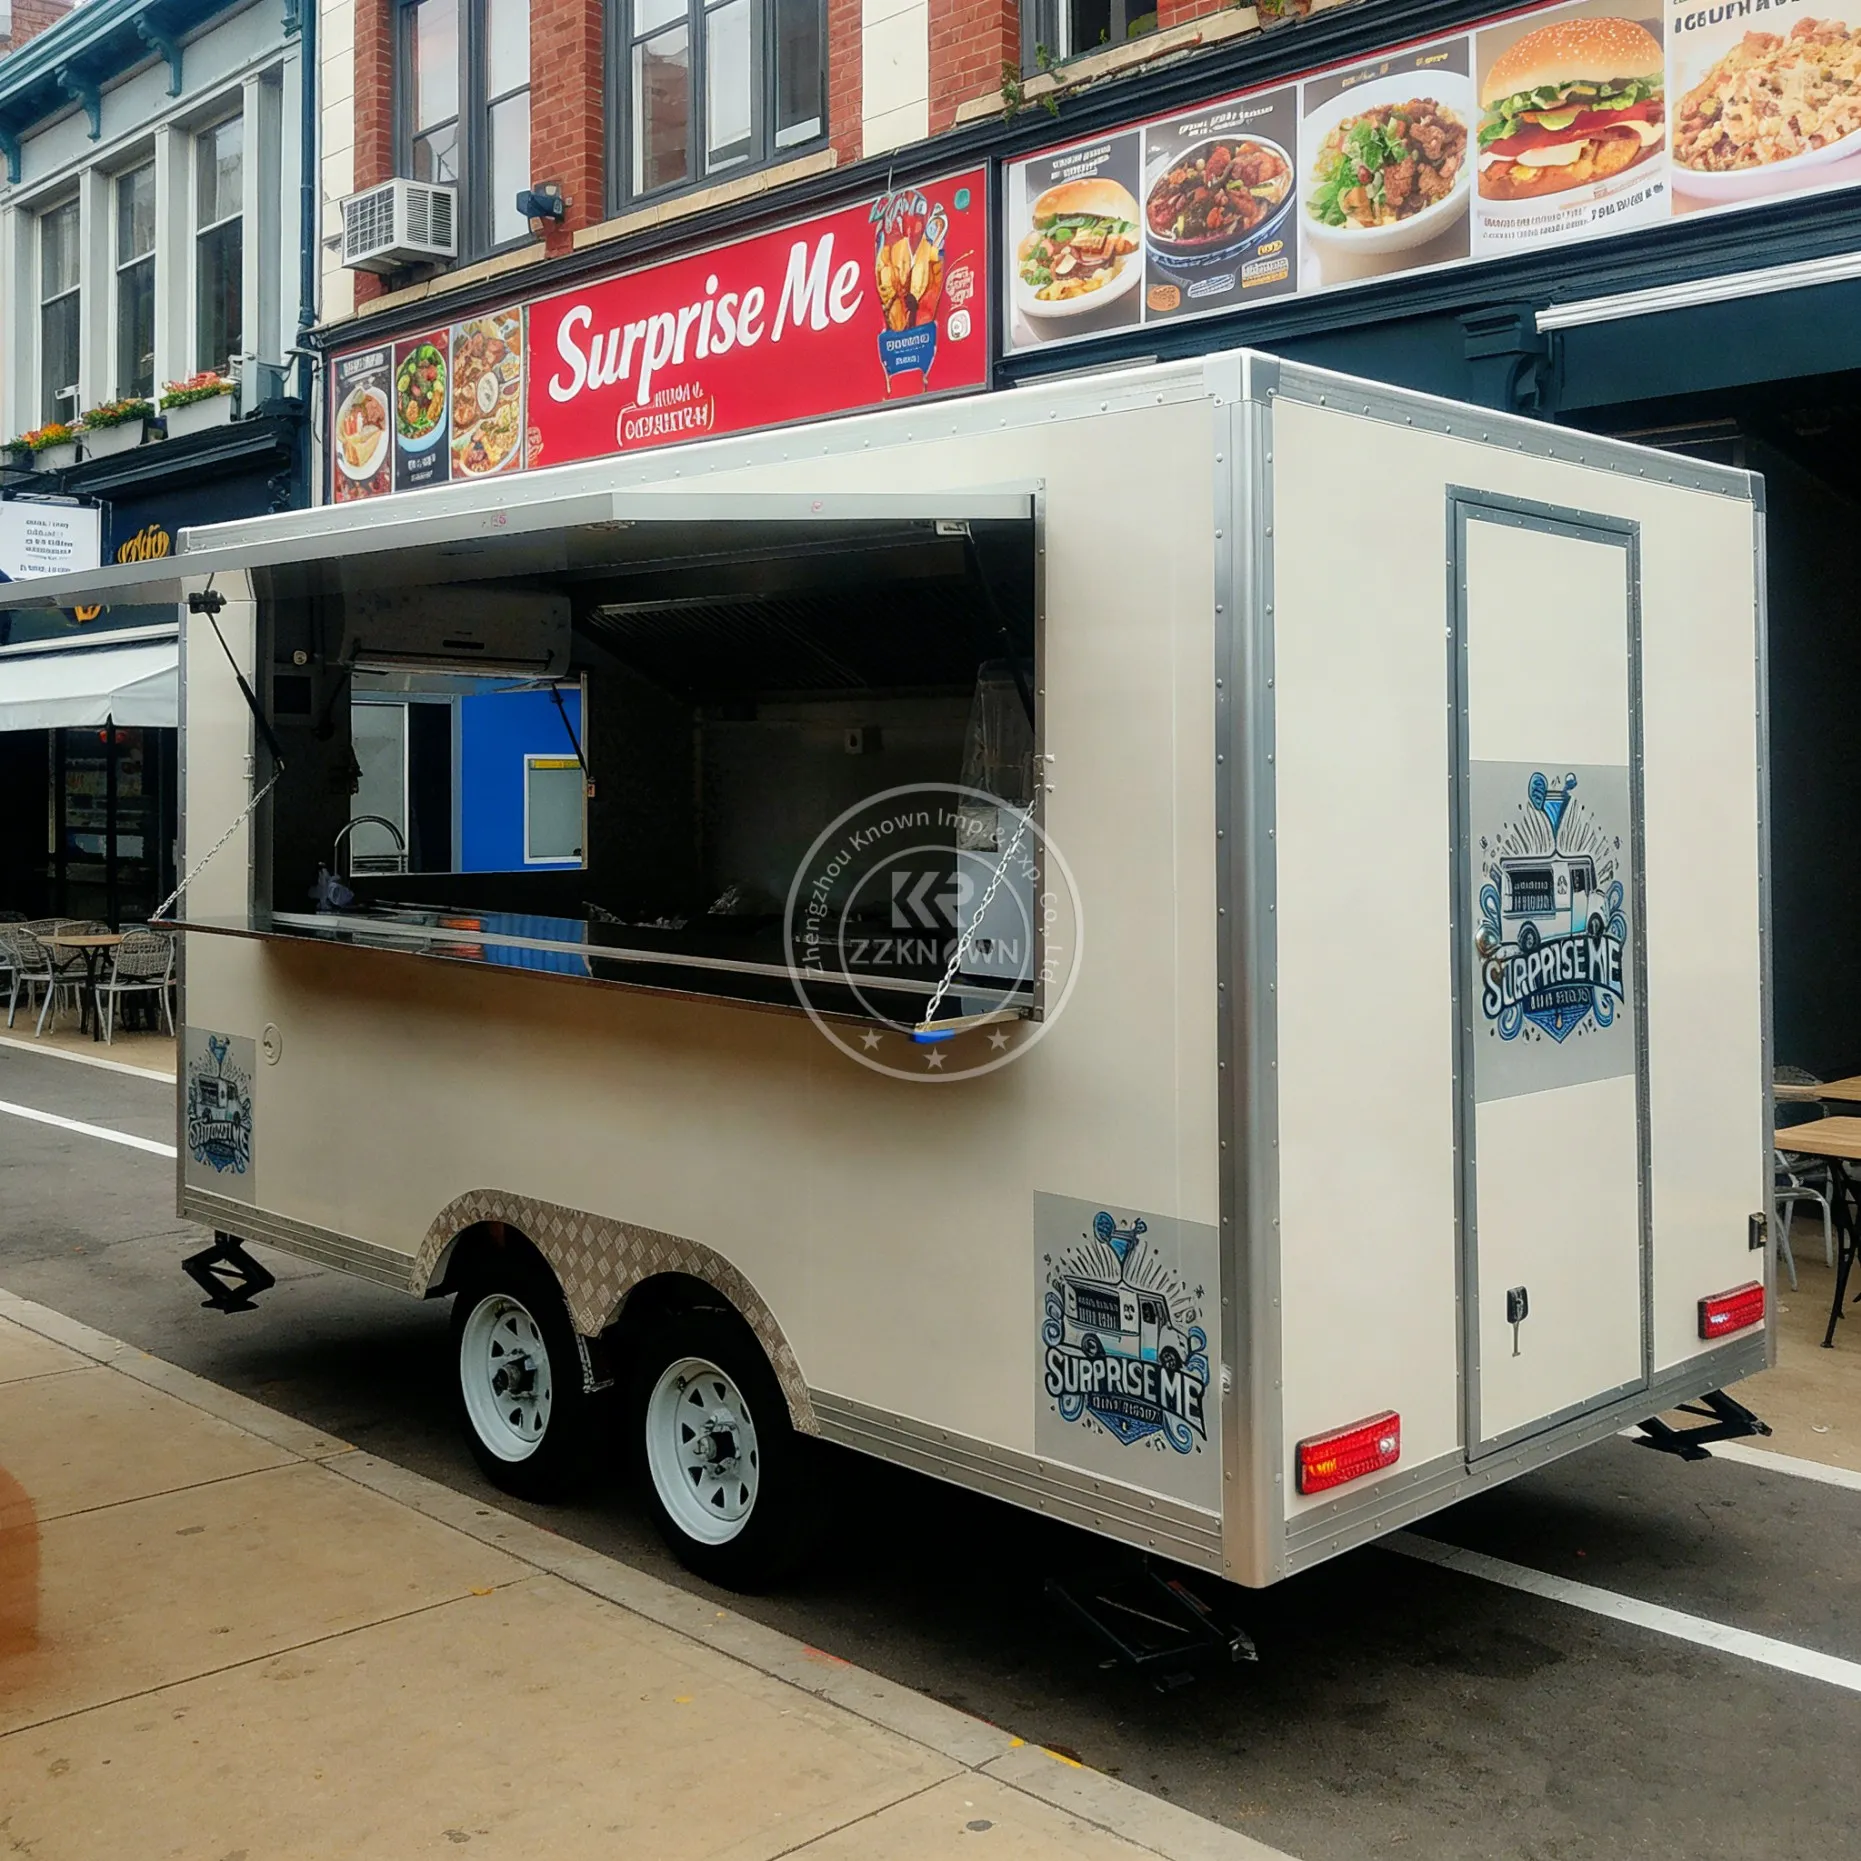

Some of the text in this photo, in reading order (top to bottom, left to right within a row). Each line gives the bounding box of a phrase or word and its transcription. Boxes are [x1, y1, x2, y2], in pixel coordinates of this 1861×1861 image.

[548, 232, 865, 405] Surprise Me
[1484, 937, 1623, 1017] SURPRISE ME
[1047, 1348, 1158, 1404] SURPRISE
[1160, 1368, 1204, 1421] ME
